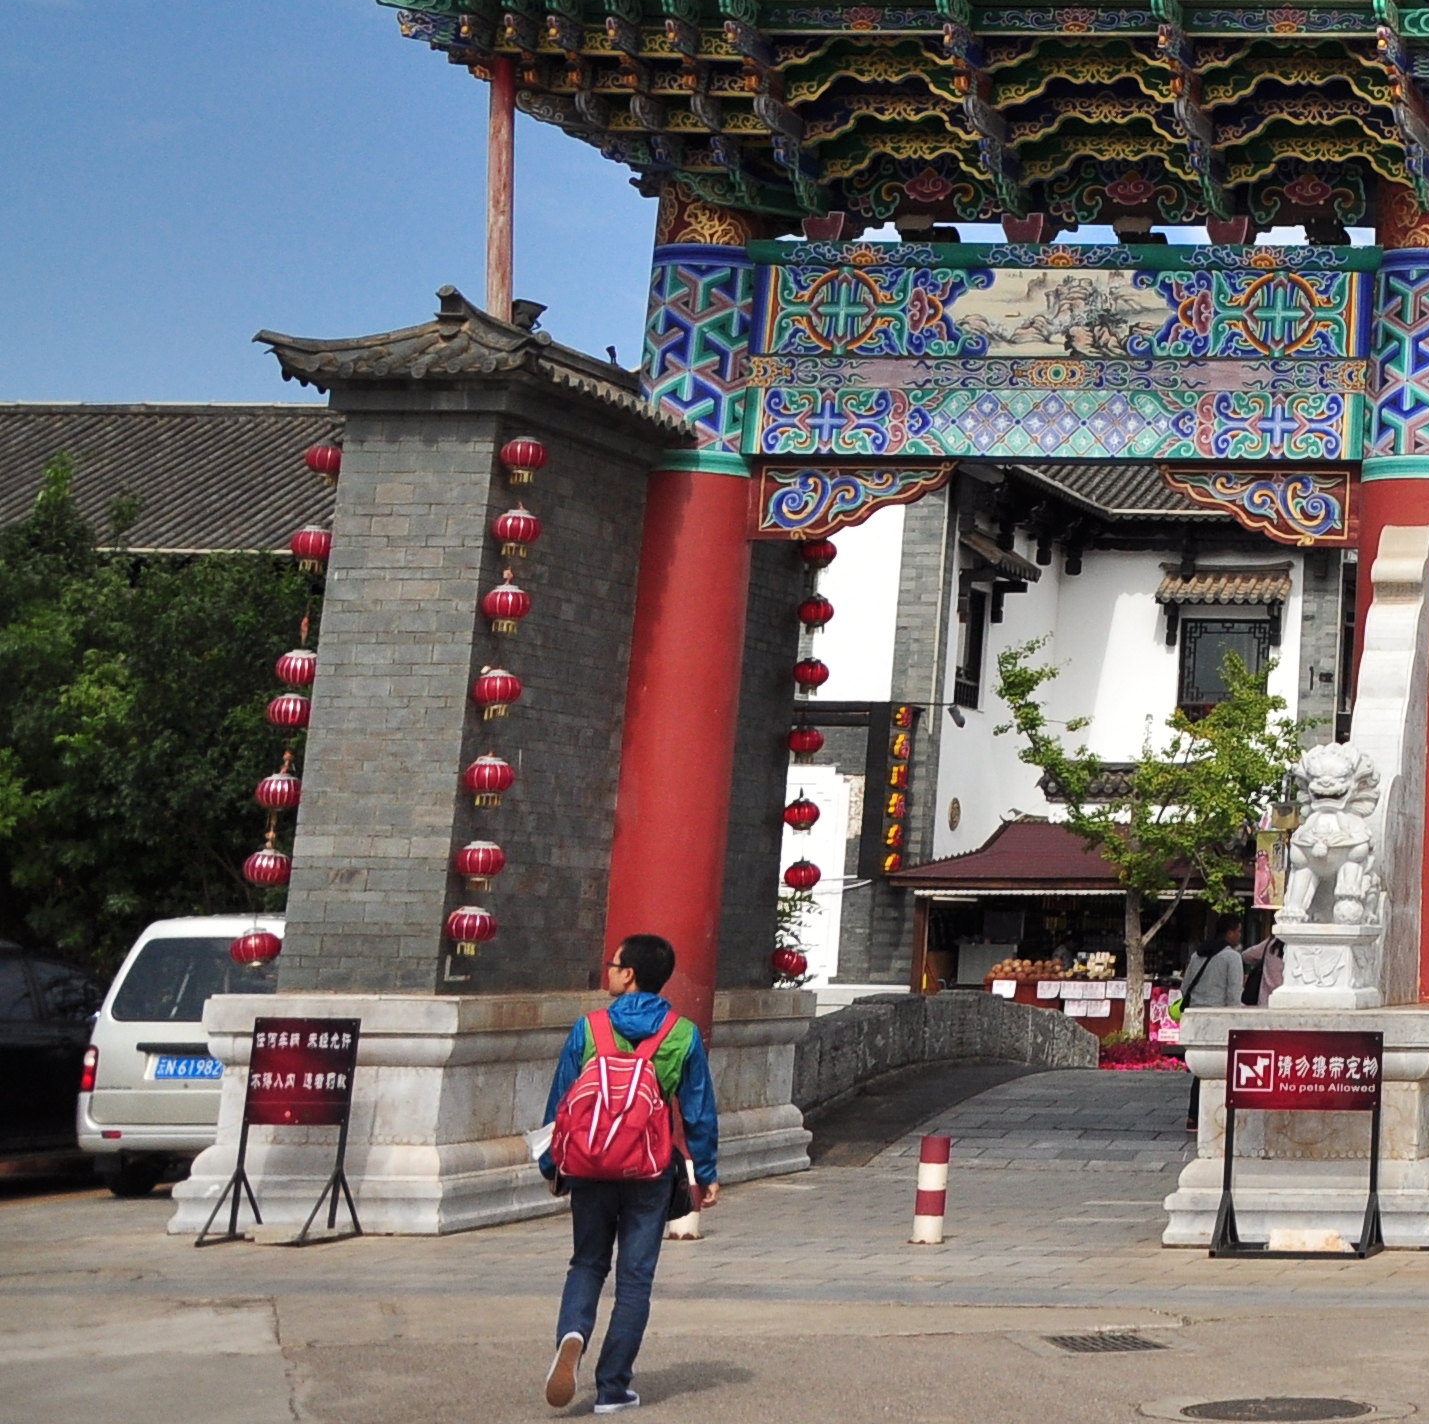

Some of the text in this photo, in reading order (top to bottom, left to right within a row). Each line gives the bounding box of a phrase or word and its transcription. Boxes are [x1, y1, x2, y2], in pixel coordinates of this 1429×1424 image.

[256, 1032, 352, 1049] 任何车辆 未经允许
[1278, 1055, 1379, 1079] 请勿携带宠物
[251, 1072, 296, 1090] 不得入内
[1279, 1082, 1376, 1094] No pets Allowed
